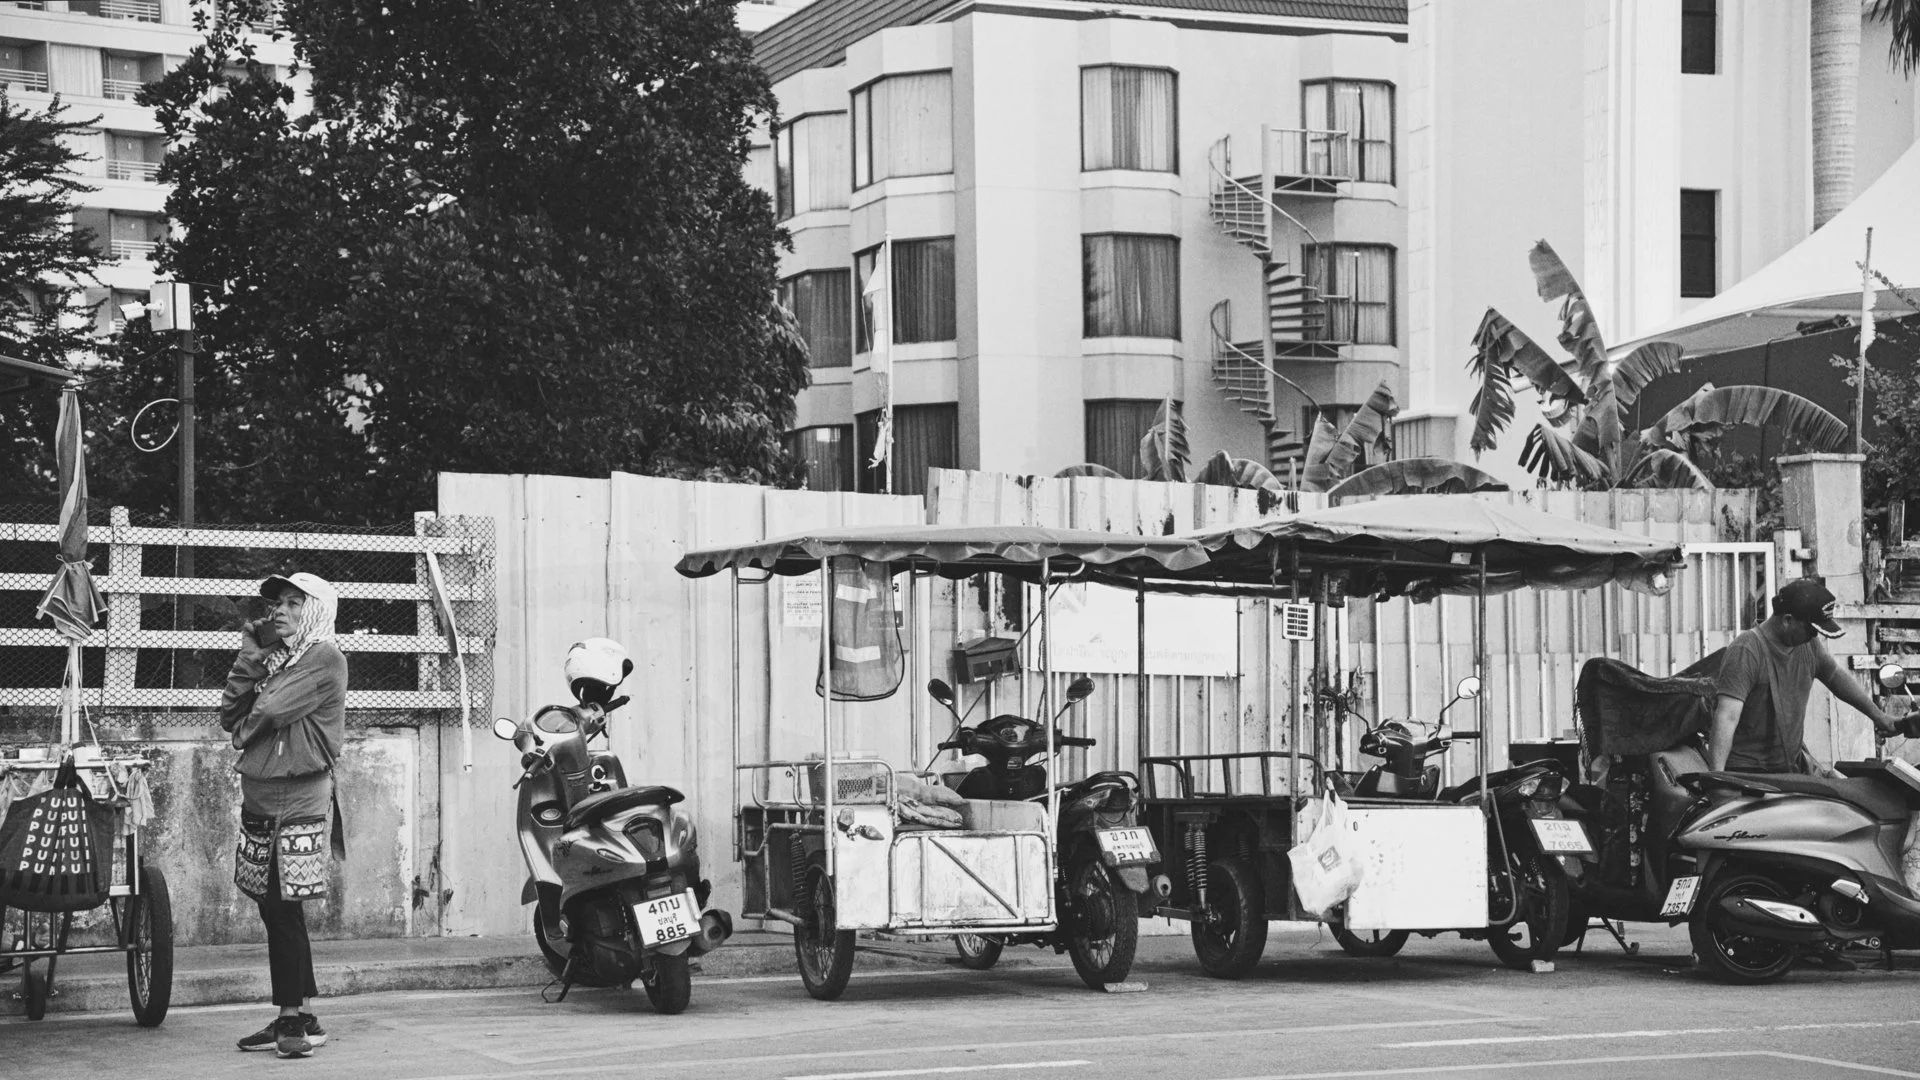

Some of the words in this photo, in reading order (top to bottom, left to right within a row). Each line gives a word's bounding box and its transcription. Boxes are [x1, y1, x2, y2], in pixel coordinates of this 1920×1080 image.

[648, 897, 680, 915] 4กบ
[657, 912, 678, 926] ชลบุรี
[656, 923, 687, 941] 885
